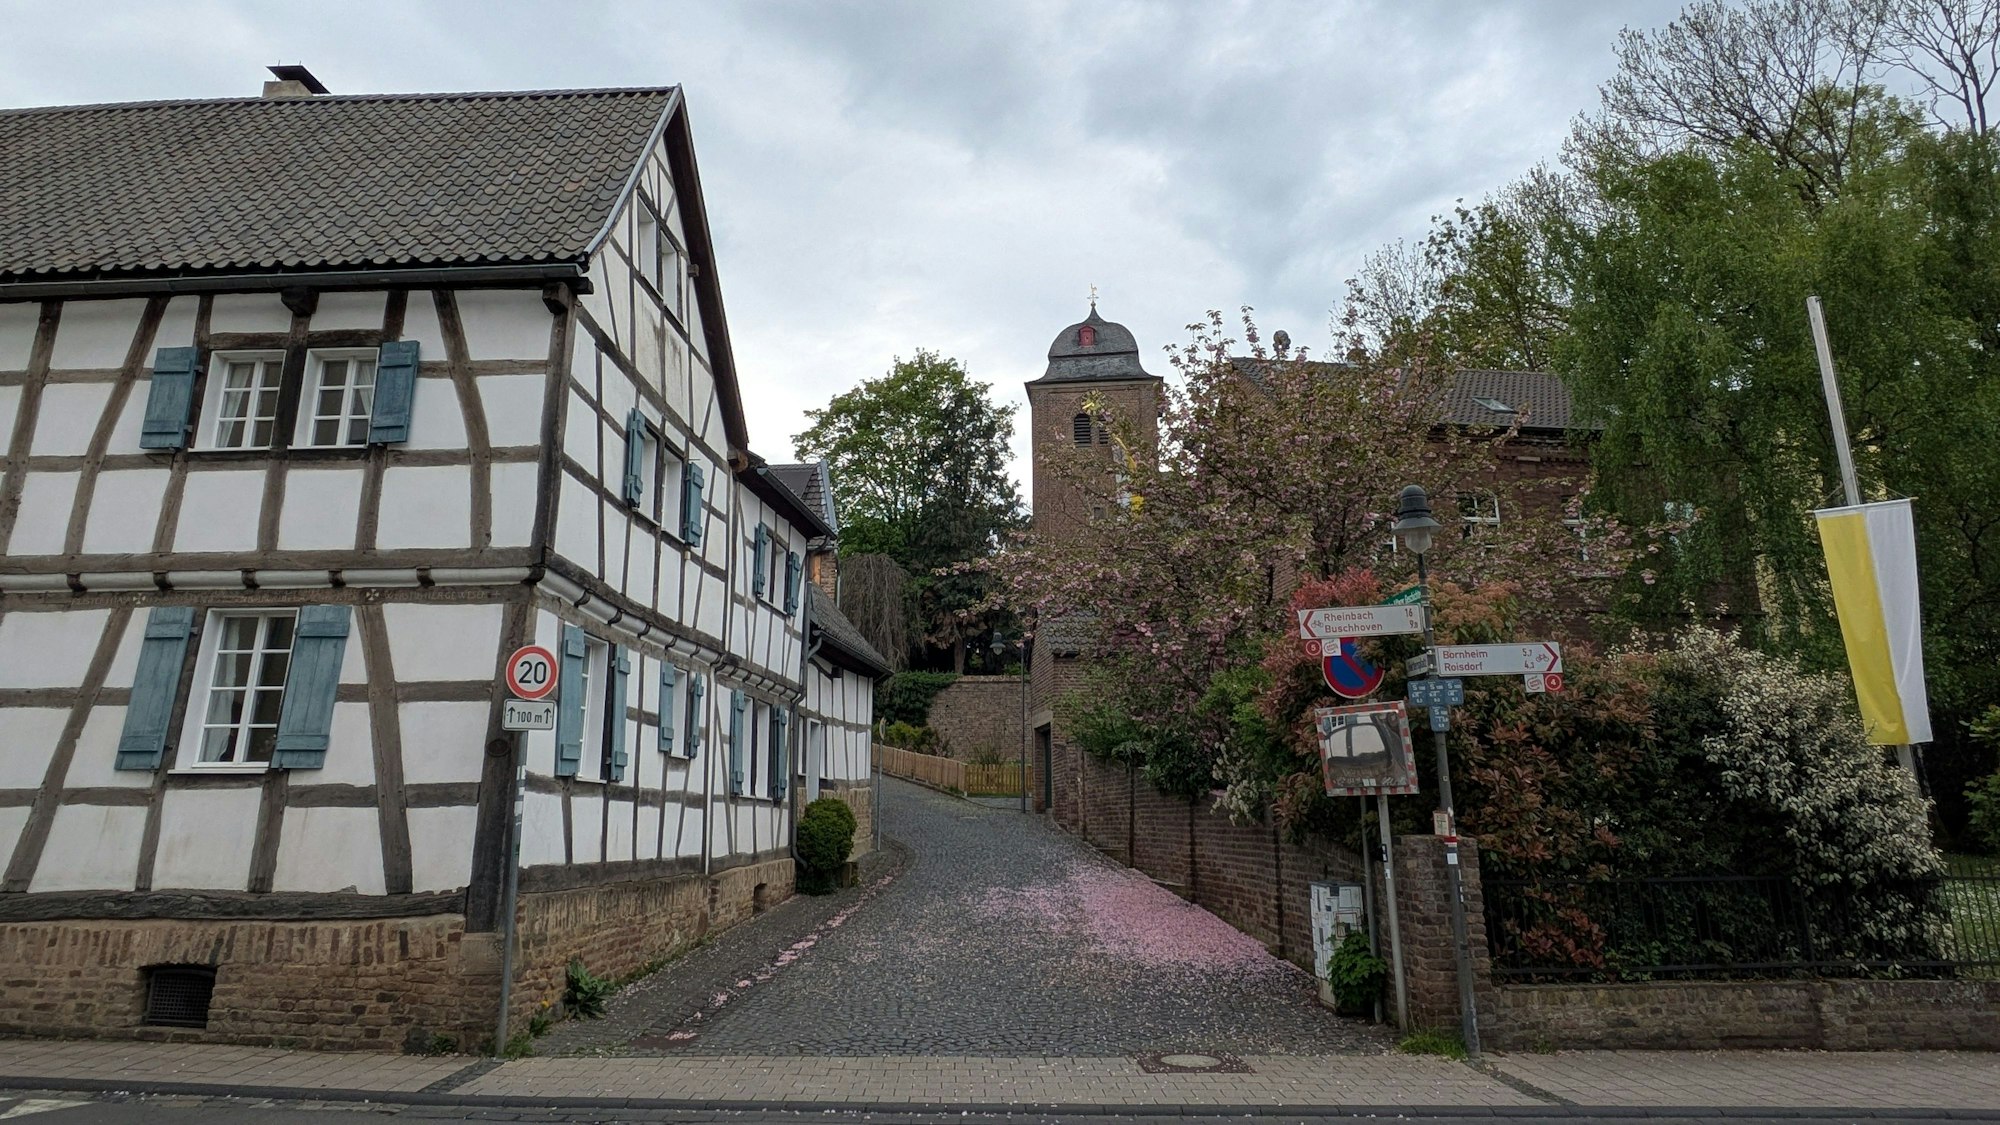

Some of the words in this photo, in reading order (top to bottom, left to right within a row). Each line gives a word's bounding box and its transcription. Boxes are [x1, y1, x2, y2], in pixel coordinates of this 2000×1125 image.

[1324, 610, 1374, 622] Rheinbach
[1404, 608, 1413, 618] 16
[1324, 623, 1383, 634] Buschhoven
[1311, 644, 1316, 652] 5
[1442, 649, 1488, 659] Bornheim
[1444, 661, 1483, 672] Roisdorf
[518, 660, 547, 685] 20
[1550, 678, 1557, 686] 4
[517, 711, 532, 723] 100
[534, 714, 543, 723] m
